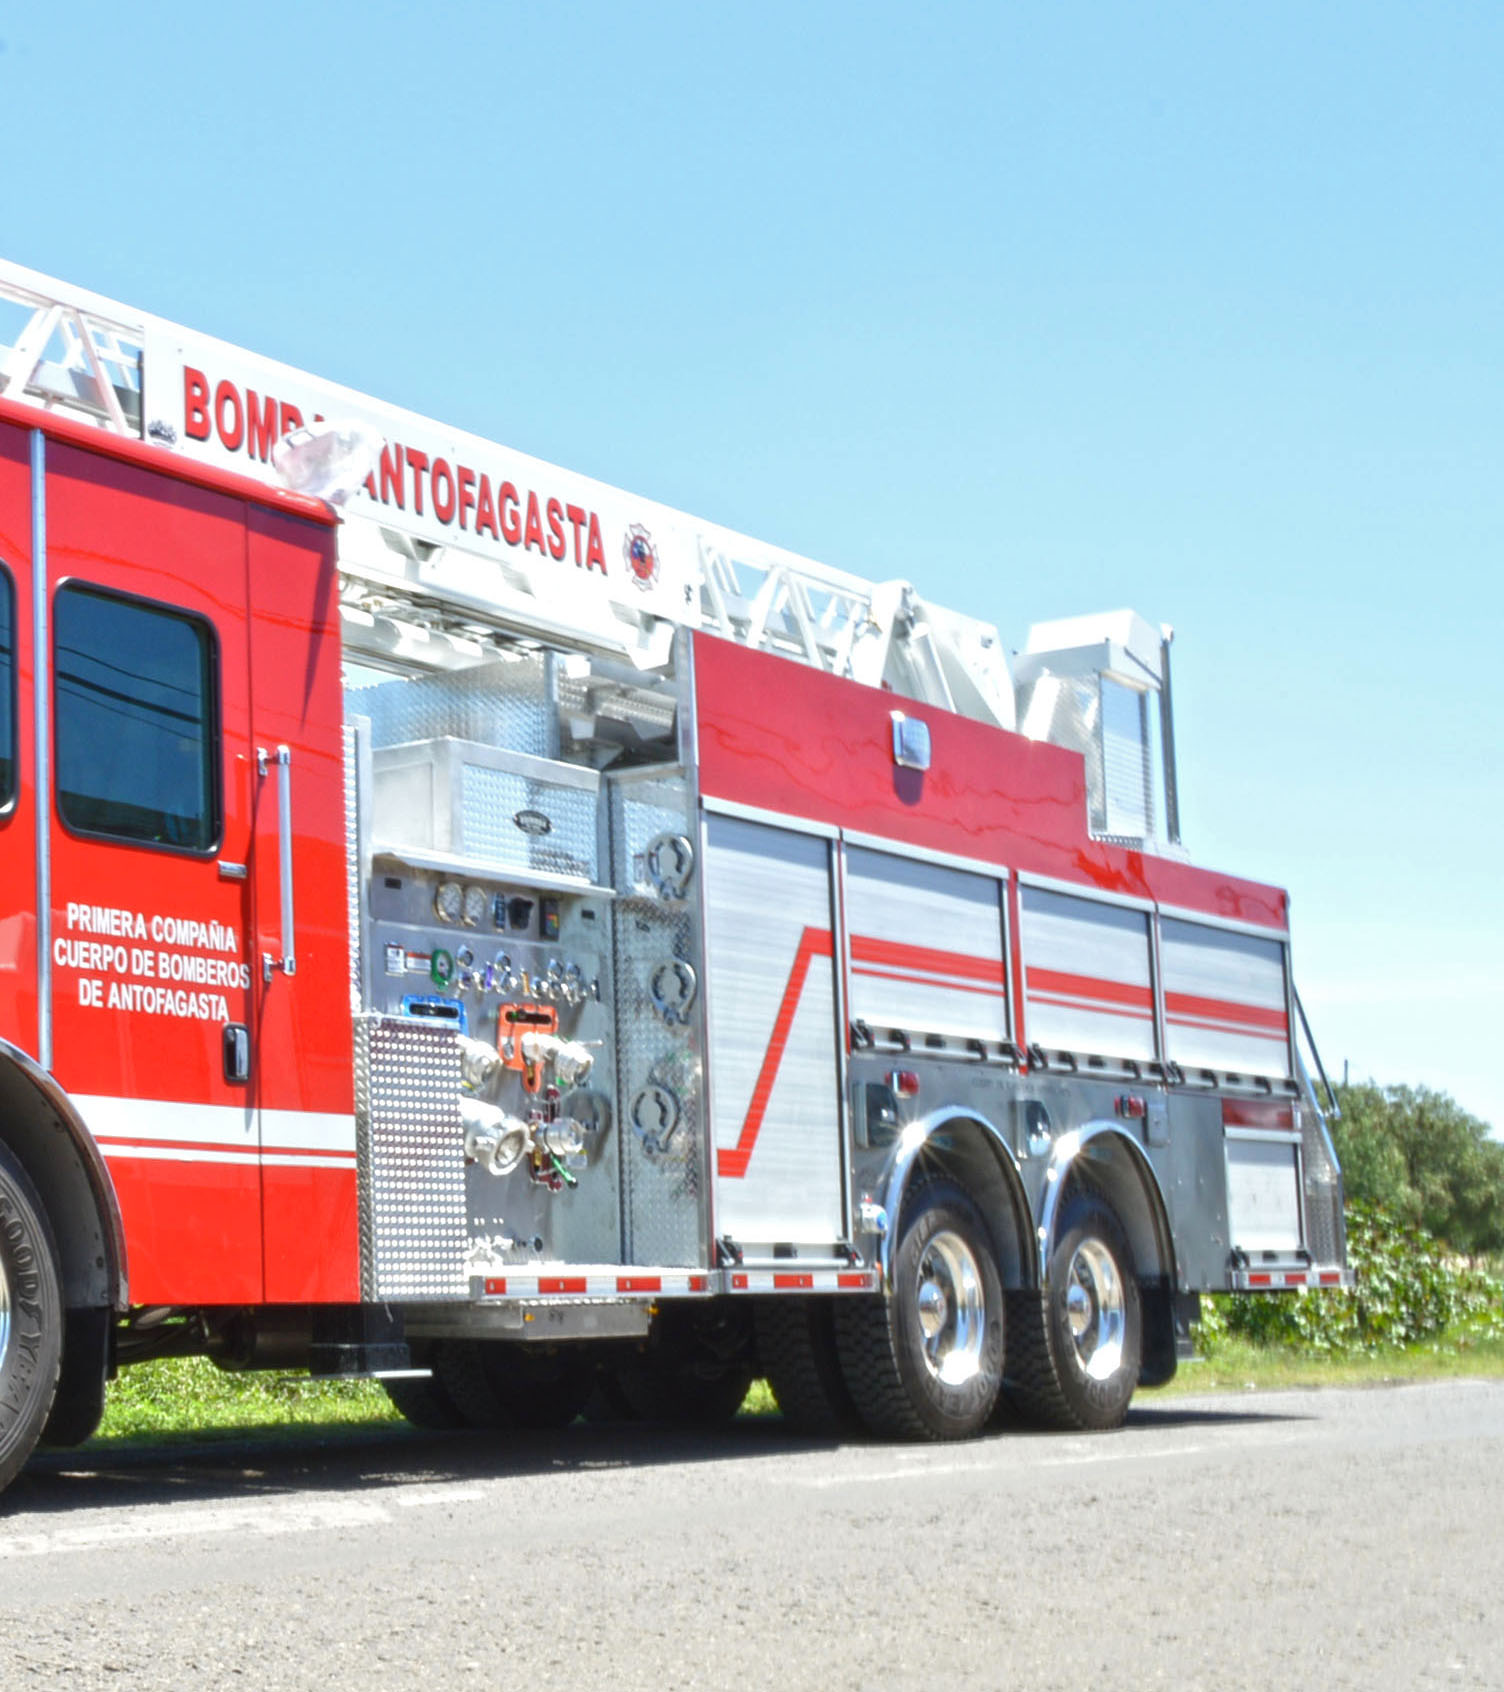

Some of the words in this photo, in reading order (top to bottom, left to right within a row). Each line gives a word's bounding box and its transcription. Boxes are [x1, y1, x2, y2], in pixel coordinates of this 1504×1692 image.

[183, 364, 326, 468] BOM
[66, 902, 148, 940] PRIMERA
[151, 914, 238, 953] COMPAÑIA
[53, 937, 128, 974] CUERPO
[131, 947, 156, 977] DE
[158, 951, 251, 990] BOMBEROS
[78, 977, 105, 1009] DE
[107, 982, 230, 1021] ANTOFAGASTA
